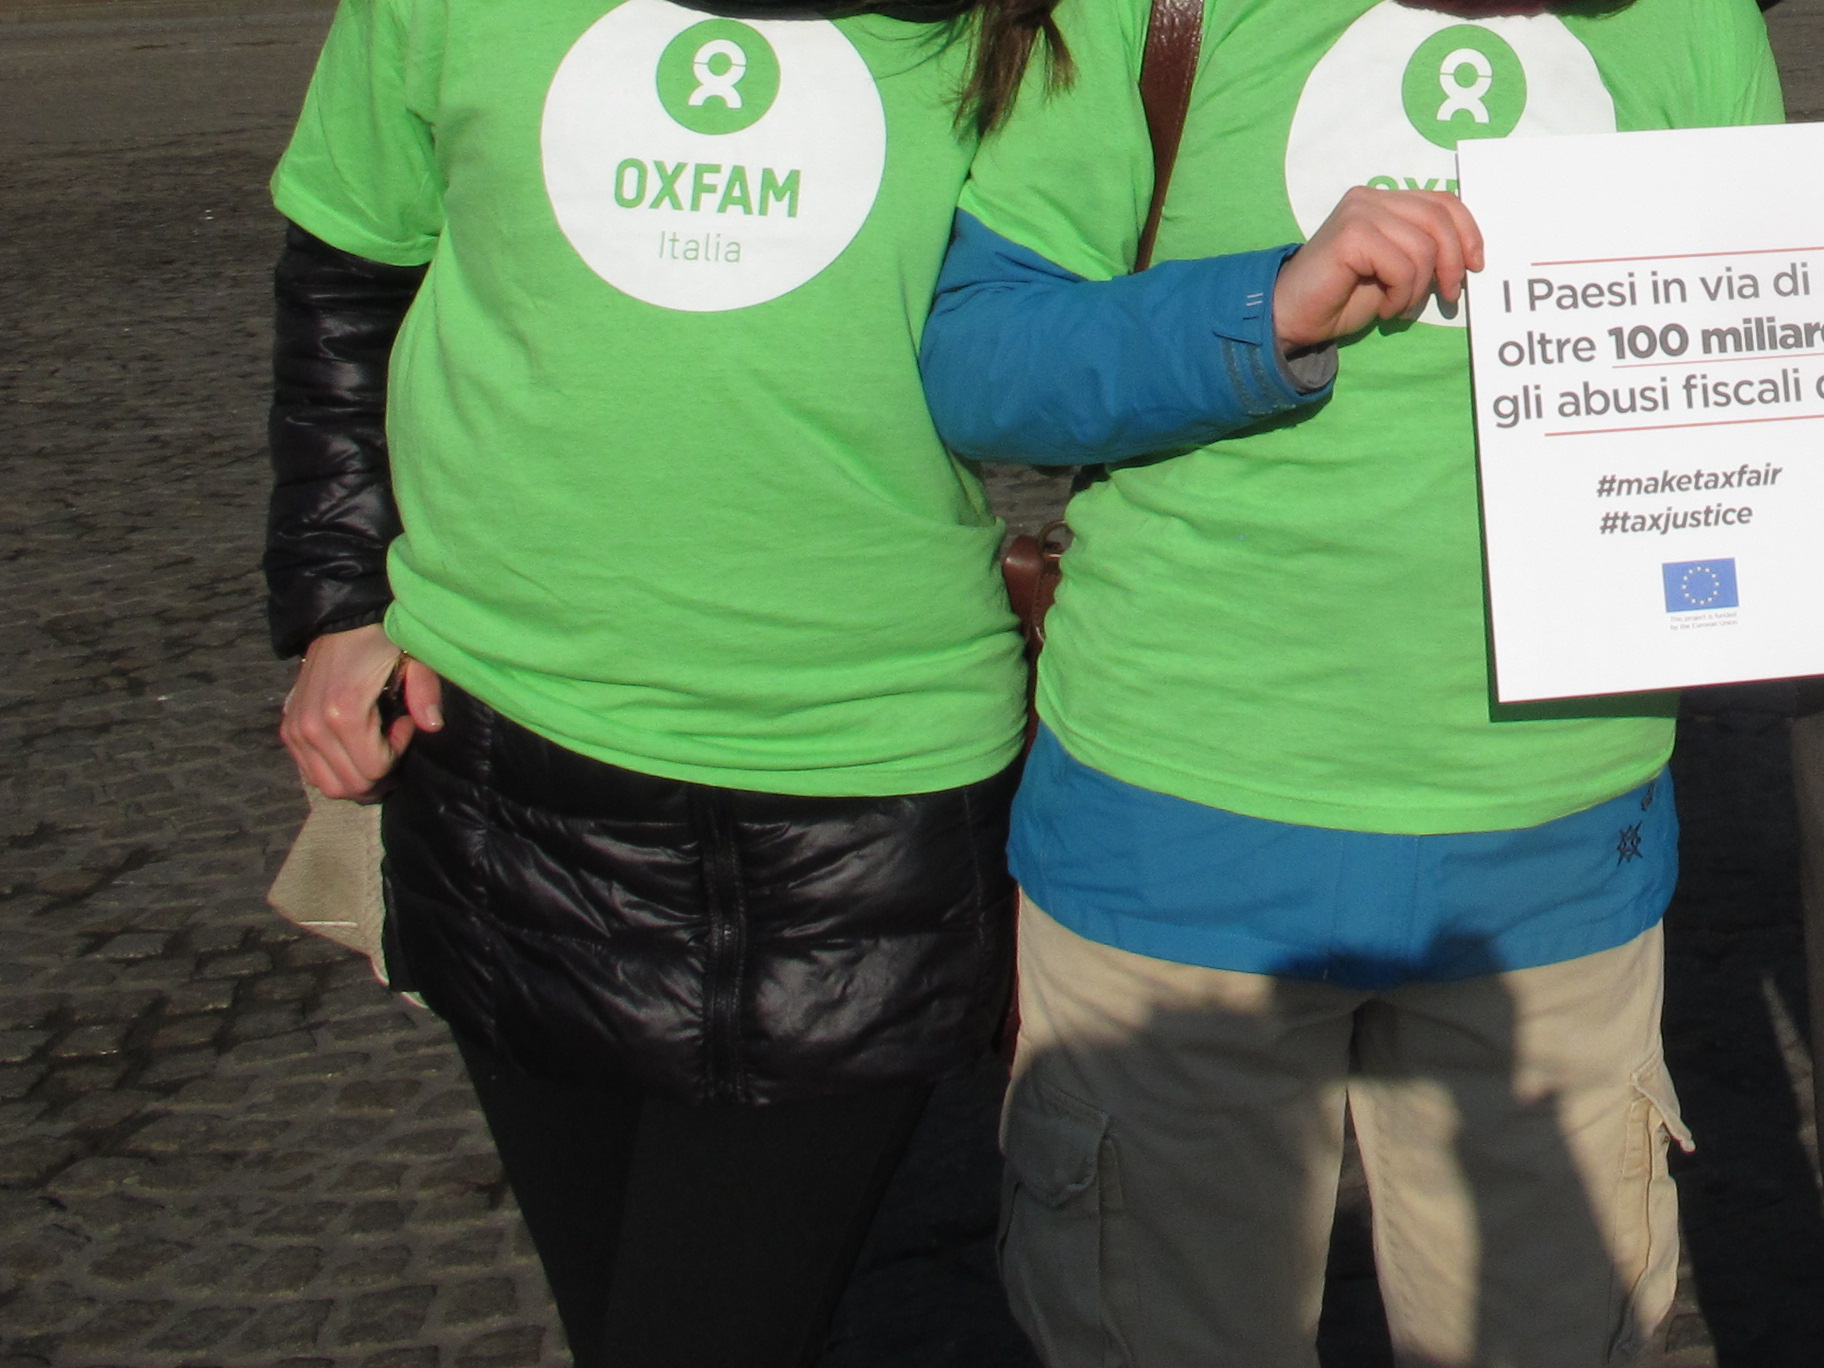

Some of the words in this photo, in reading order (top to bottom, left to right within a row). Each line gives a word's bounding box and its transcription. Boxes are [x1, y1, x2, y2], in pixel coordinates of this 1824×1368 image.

[613, 157, 802, 218] OXFAM
[658, 230, 743, 264] Italia
[1501, 279, 1513, 314] I
[1526, 271, 1638, 313] Paesi
[1649, 269, 1688, 306] in
[1698, 265, 1761, 303] via
[1772, 260, 1811, 299] di
[1496, 329, 1598, 368] oltre
[1606, 322, 1691, 361] 100
[1491, 383, 1544, 430] gli
[1556, 375, 1671, 419] abusi
[1681, 366, 1803, 410] fiscali
[1595, 461, 1784, 499] #maketaxfair
[1598, 502, 1754, 537] #taxjustice
